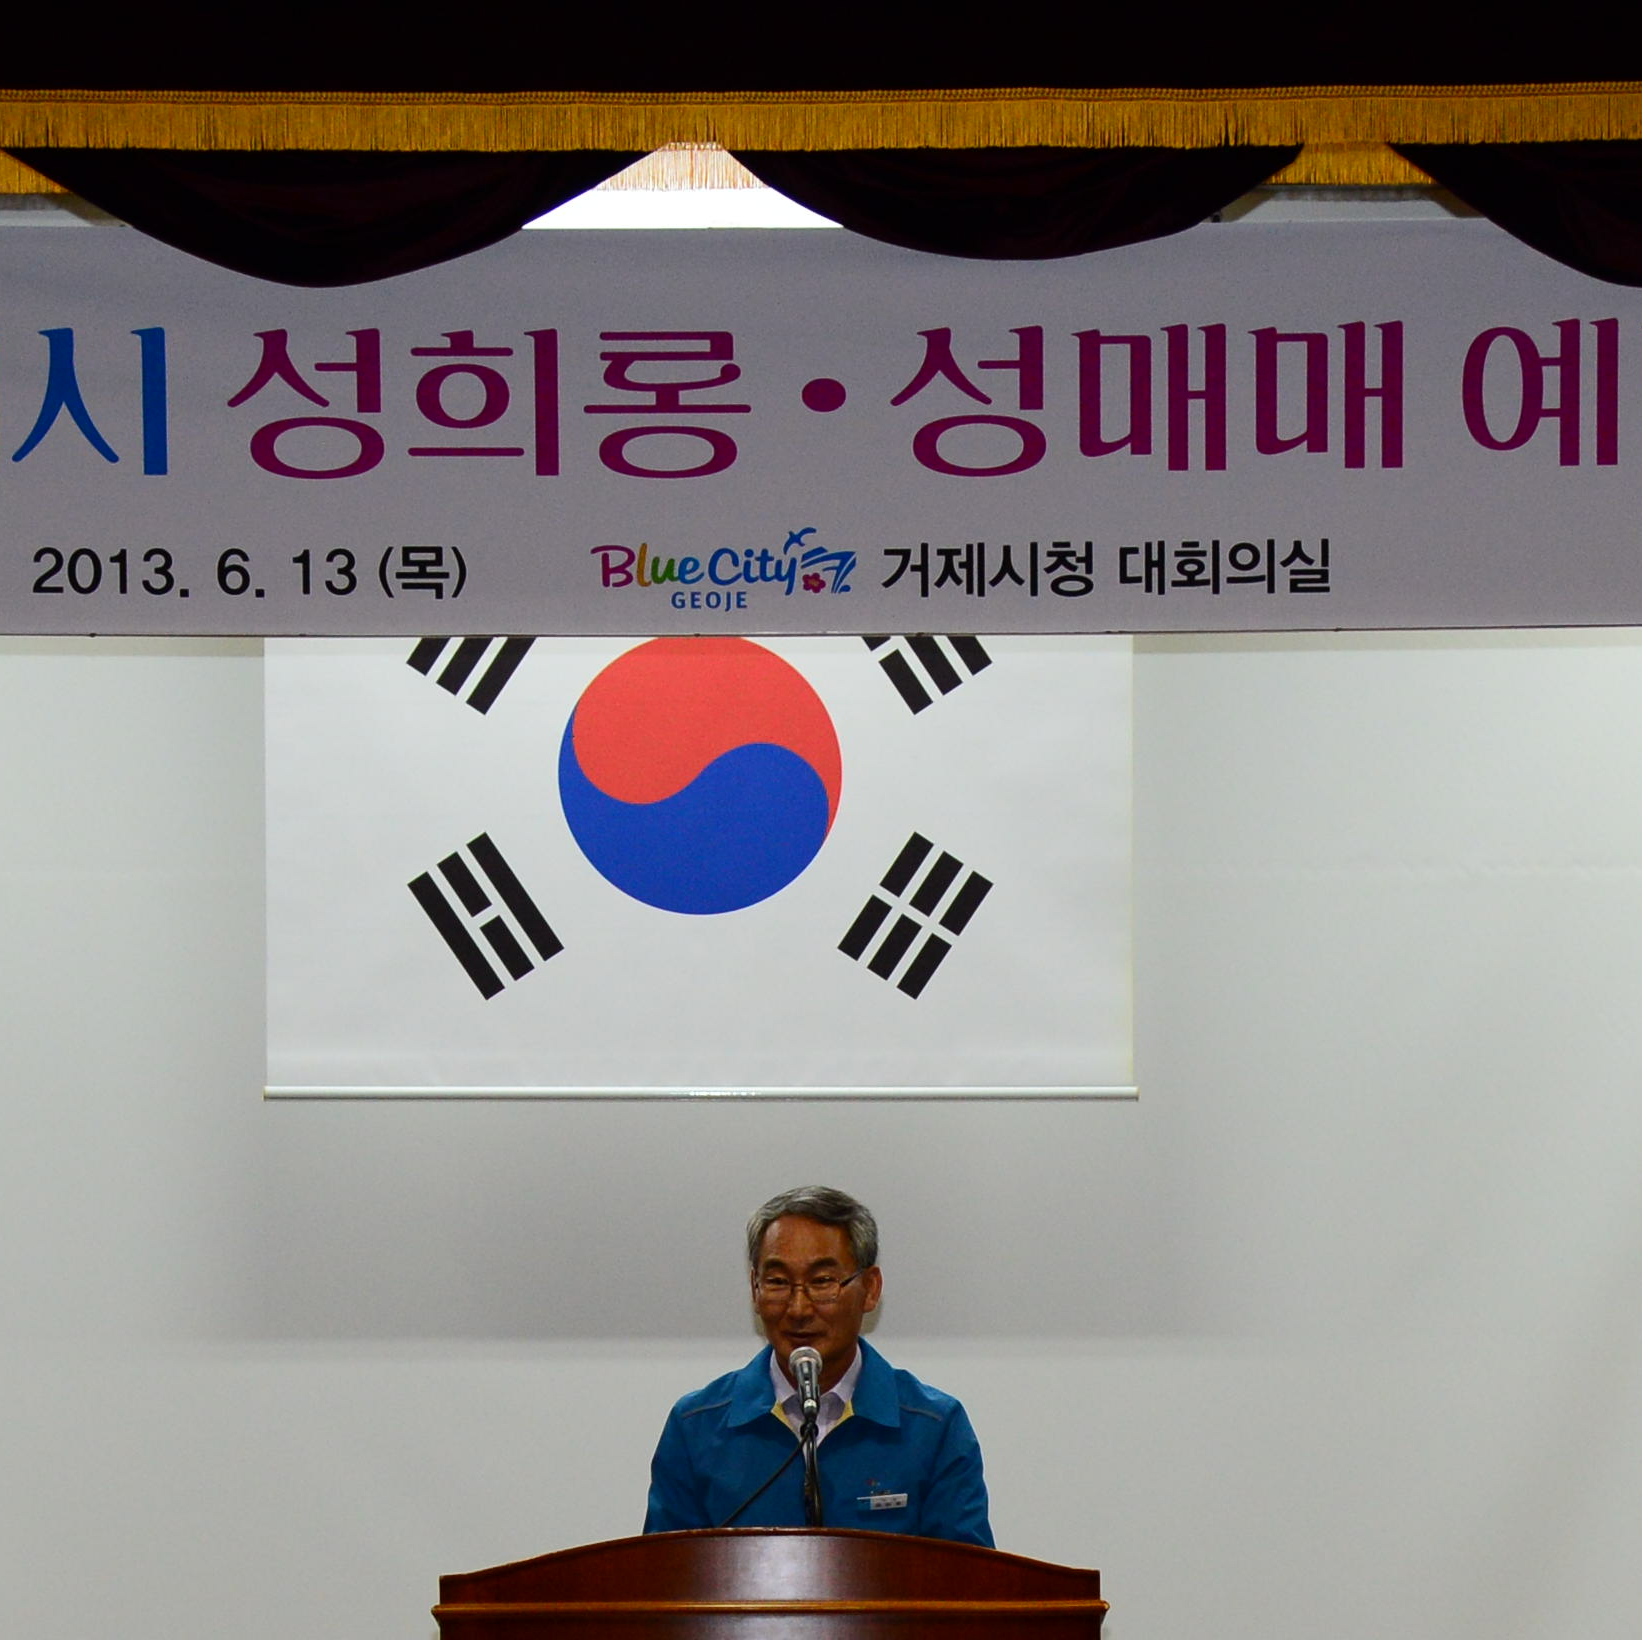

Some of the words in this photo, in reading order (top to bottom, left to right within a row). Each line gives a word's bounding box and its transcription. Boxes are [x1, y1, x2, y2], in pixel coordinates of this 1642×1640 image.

[32, 546, 190, 598] 2013.
[216, 547, 265, 598] 6.
[291, 548, 357, 596] 13
[378, 545, 467, 600] (목)
[590, 543, 704, 588] Blue
[708, 547, 798, 596] City
[880, 539, 1094, 599] 거제시청
[1120, 537, 1333, 597] 대회의실
[671, 590, 748, 612] GEOJE
